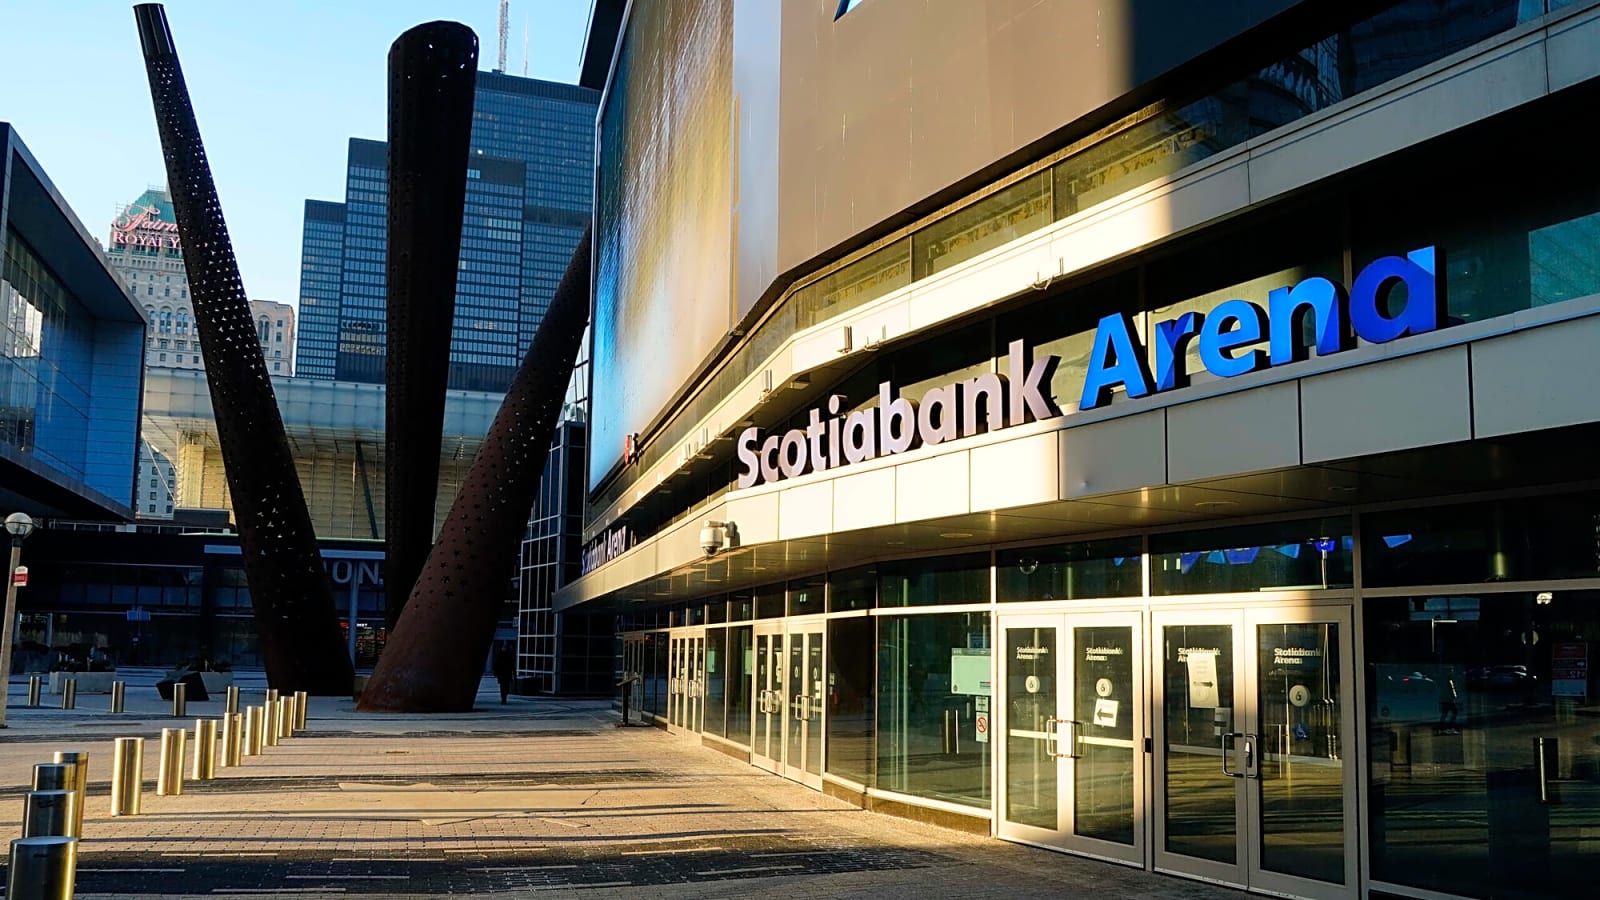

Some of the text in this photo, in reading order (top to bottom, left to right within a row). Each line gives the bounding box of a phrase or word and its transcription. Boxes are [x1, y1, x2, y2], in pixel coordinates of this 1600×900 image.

[737, 245, 1437, 489] Scotiabank Arena
[607, 525, 626, 561] Arena
[1274, 656, 1303, 665] Arena
